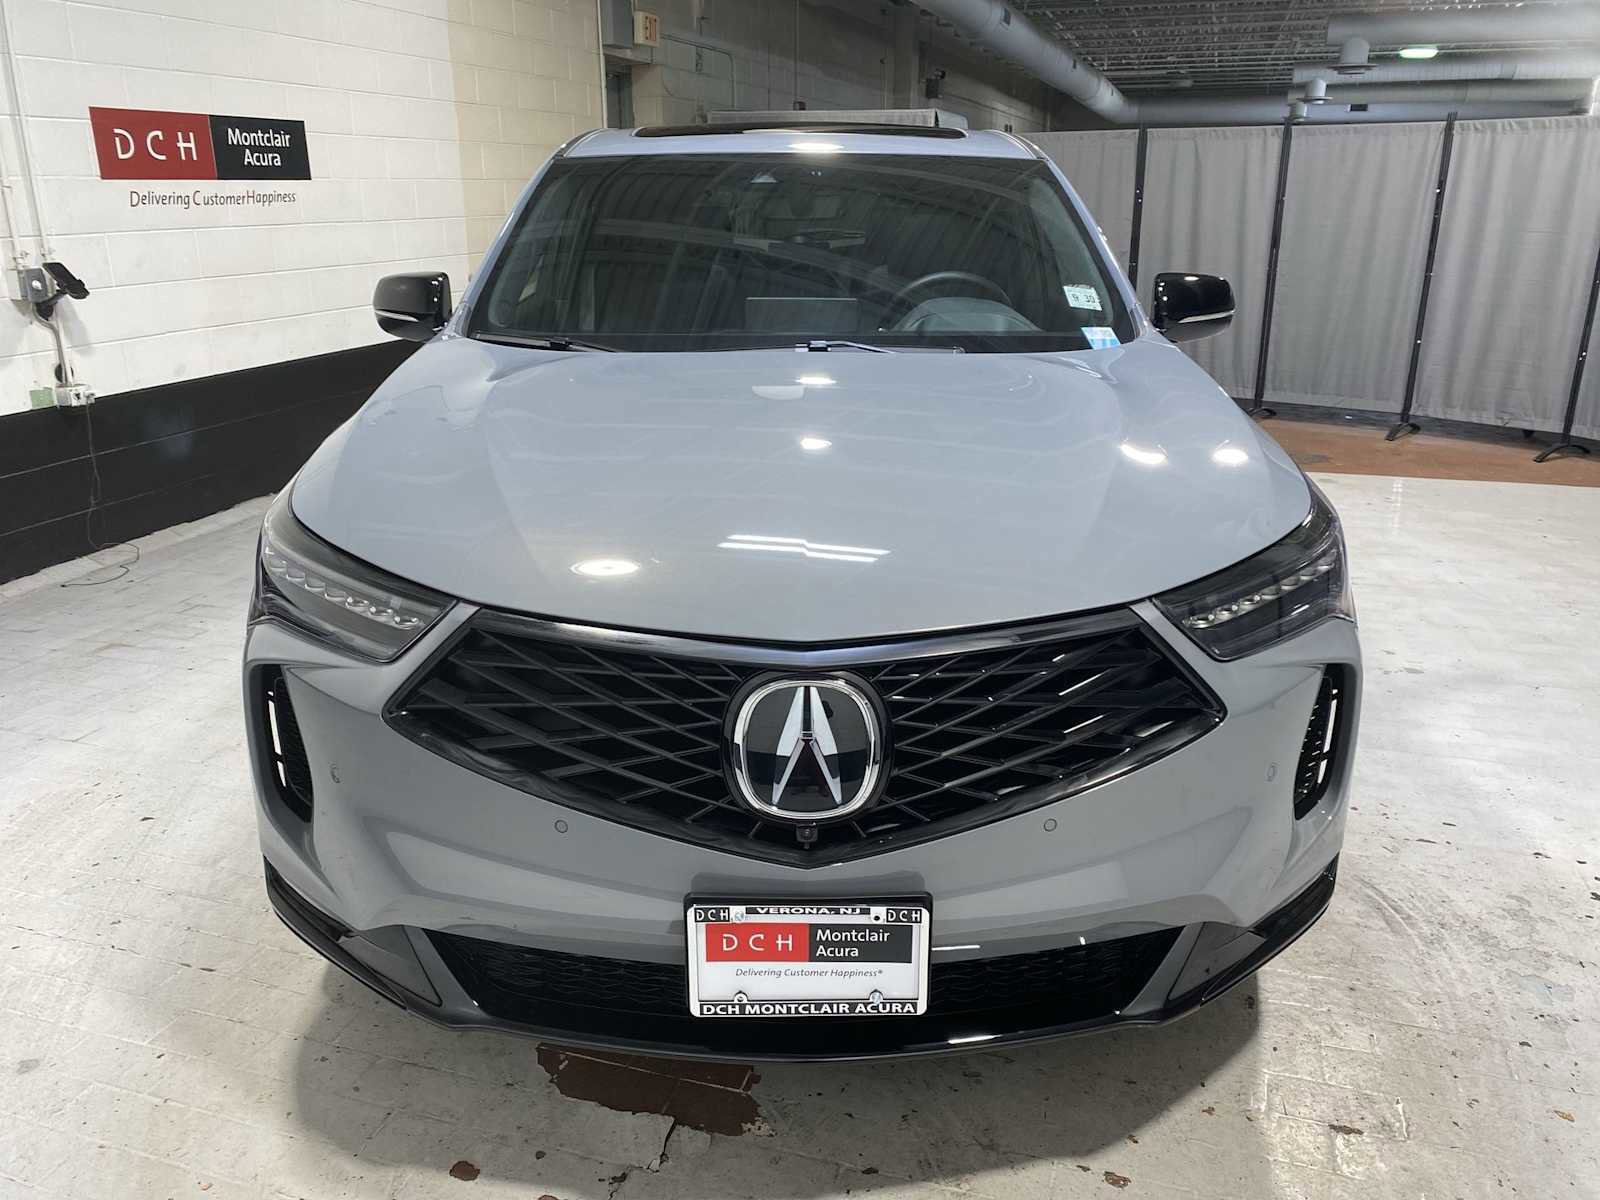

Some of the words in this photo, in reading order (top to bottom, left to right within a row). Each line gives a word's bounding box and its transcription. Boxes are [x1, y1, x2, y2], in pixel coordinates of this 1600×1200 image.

[227, 128, 291, 148] Montclair
[244, 149, 281, 166] Acura
[130, 191, 190, 209] Delivering
[246, 190, 296, 207] Happiness
[695, 909, 730, 922] DCH
[839, 906, 861, 915] NJ
[887, 909, 922, 922] DCH
[816, 929, 890, 942] Montclair
[722, 933, 793, 952] DCH
[816, 945, 859, 957] Acura
[735, 968, 782, 979] Delivering
[784, 968, 829, 977] Customer
[703, 1004, 740, 1015] DCH
[746, 1003, 850, 1015] MONTCLAIR
[853, 1002, 915, 1014] ACURA
